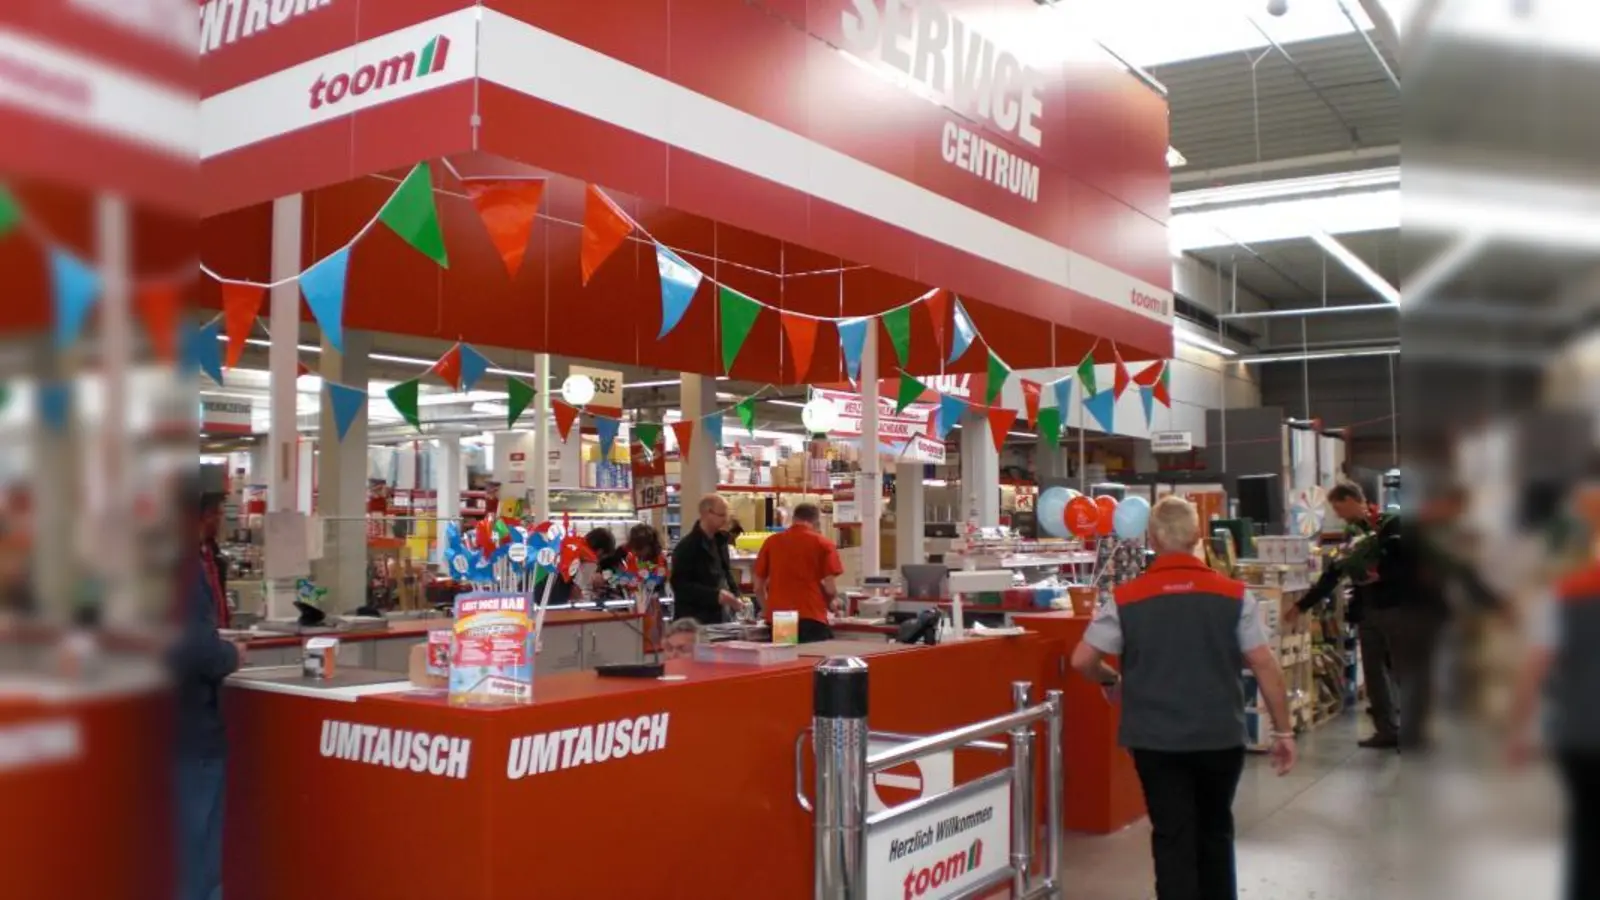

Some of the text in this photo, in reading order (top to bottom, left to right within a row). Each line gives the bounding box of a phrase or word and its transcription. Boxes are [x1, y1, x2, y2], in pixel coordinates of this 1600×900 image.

[308, 52, 416, 110] toom
[841, 0, 1044, 148] SERVICE
[941, 121, 1040, 203] CENTRUM
[320, 720, 471, 779] UMTAUSCH
[506, 713, 669, 779] UMTAUSCH
[889, 806, 993, 862] Herzlich Willkommen
[903, 849, 967, 900] toom
